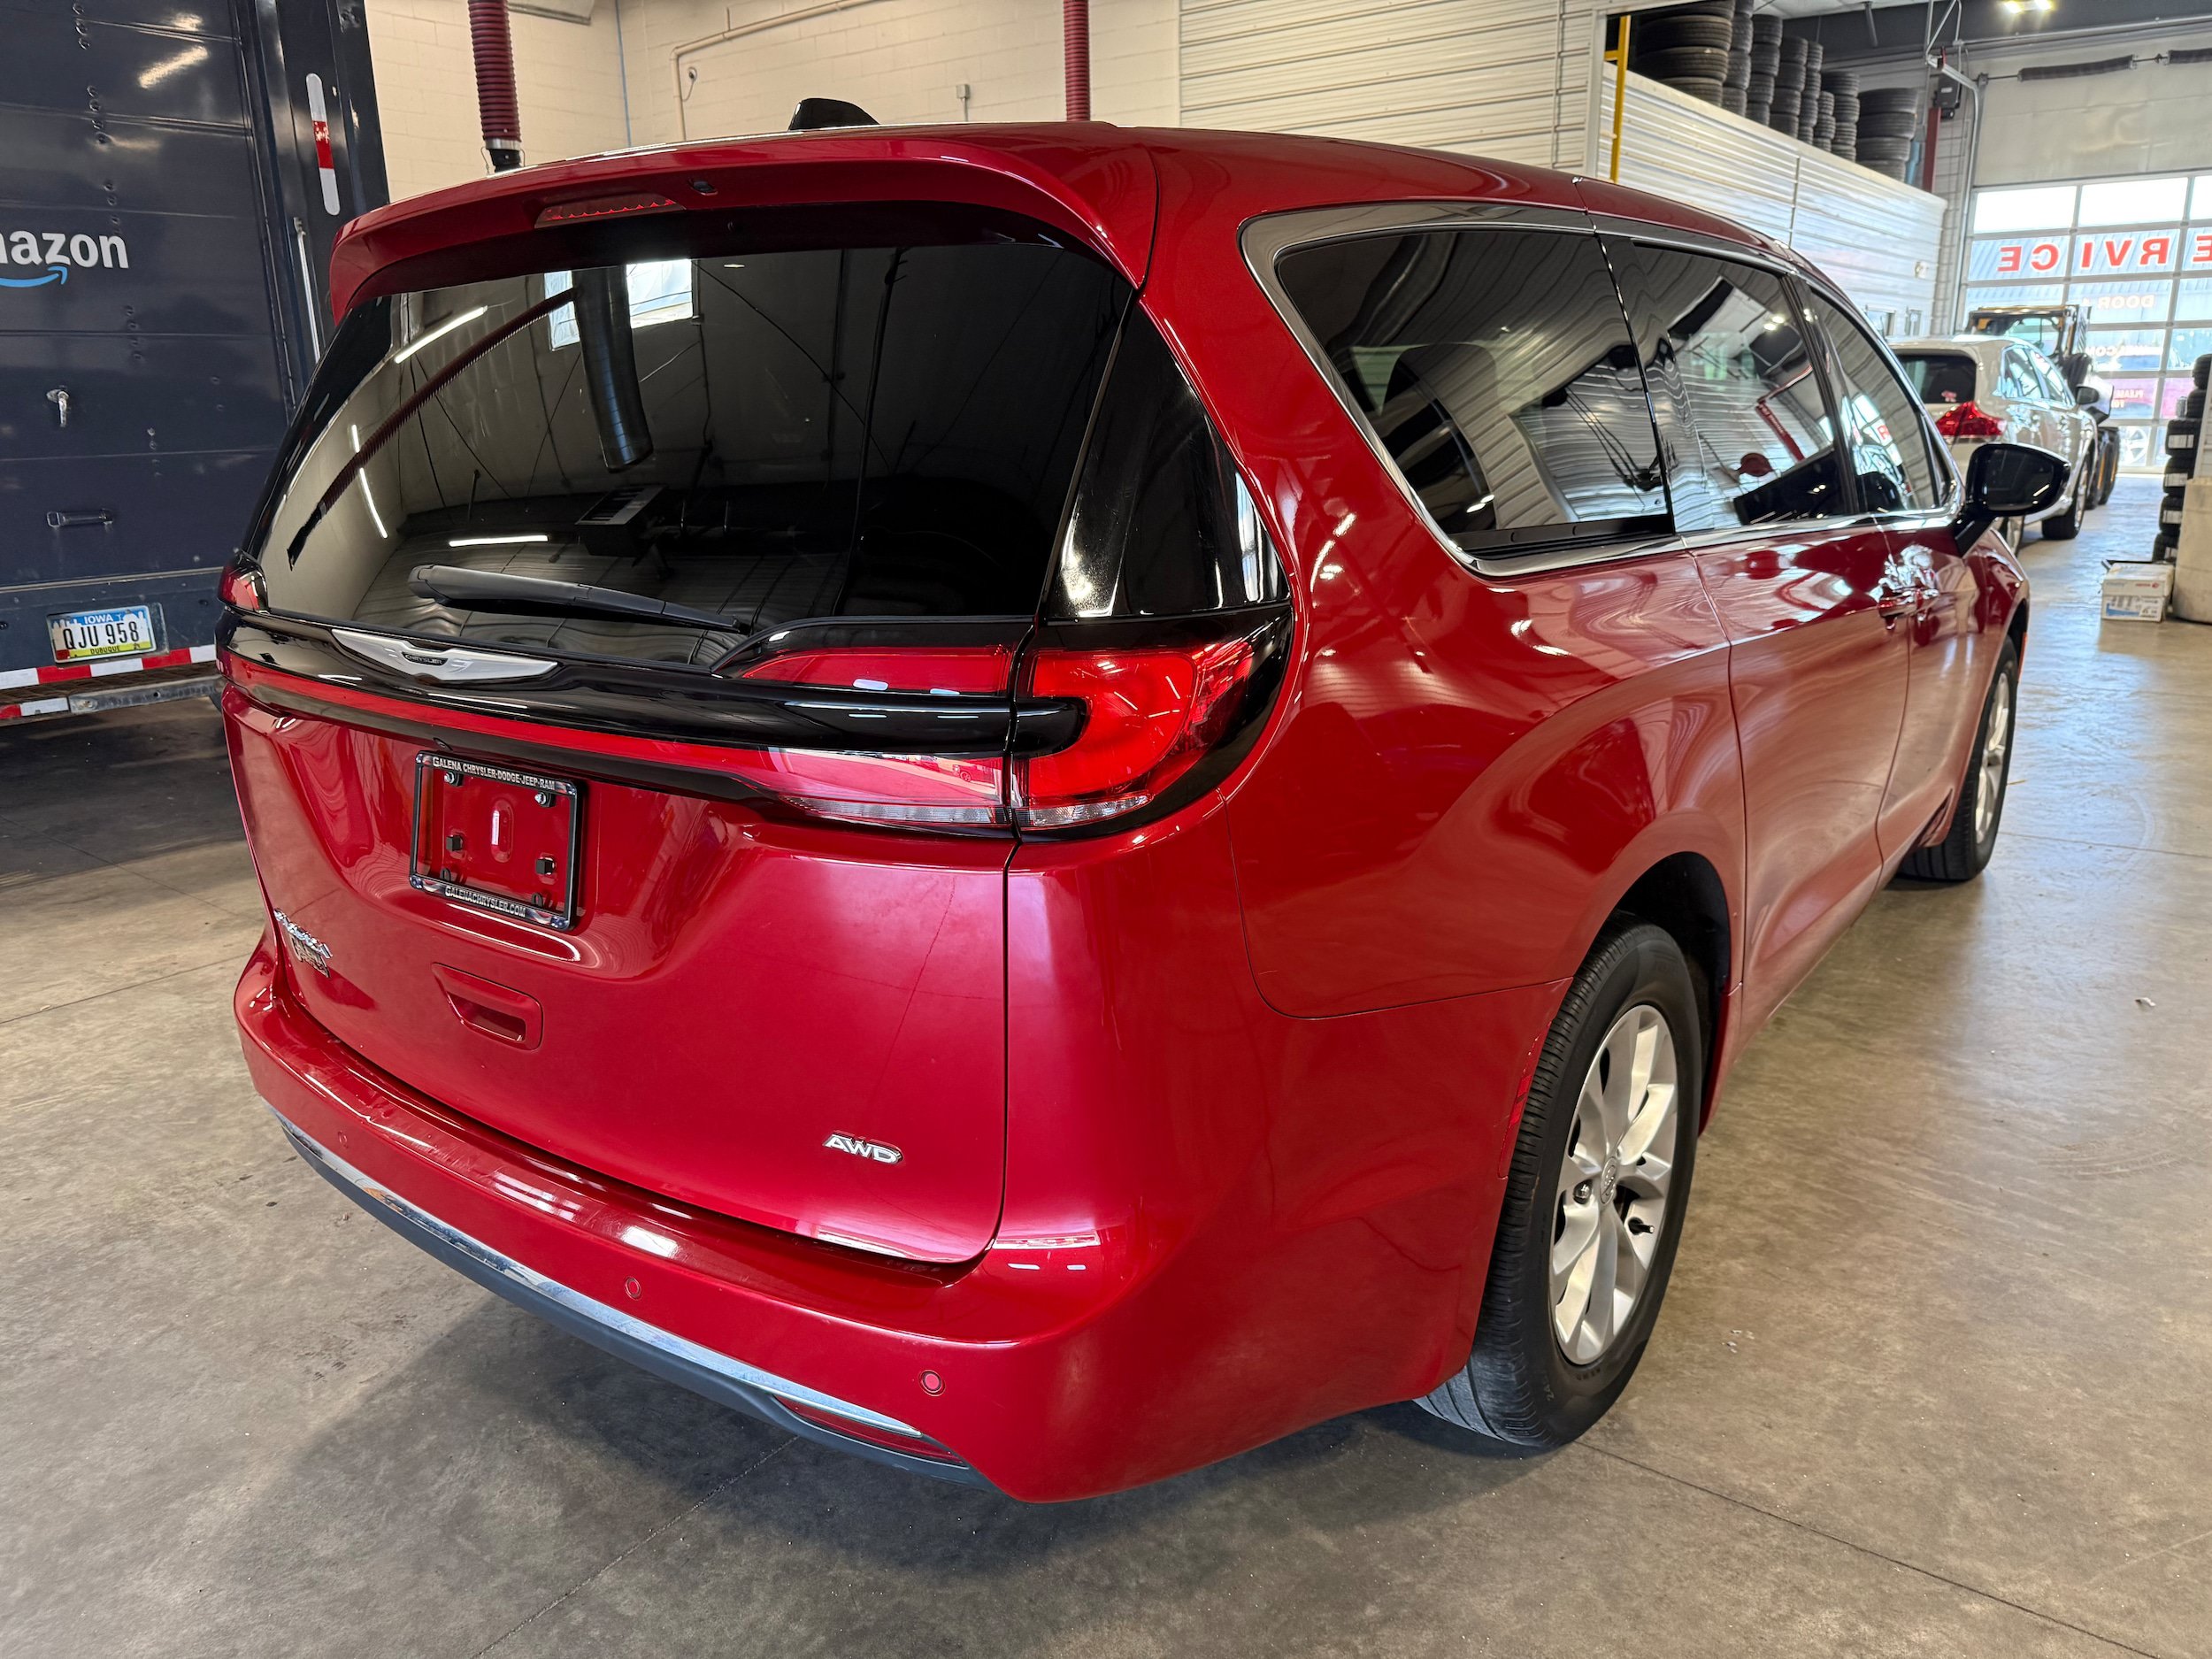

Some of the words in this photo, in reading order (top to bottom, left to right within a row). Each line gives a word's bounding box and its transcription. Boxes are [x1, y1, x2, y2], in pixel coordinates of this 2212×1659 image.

[0, 230, 129, 268] azon
[83, 613, 114, 624] IOWA
[63, 625, 99, 649] QJU
[105, 621, 140, 645] 958
[90, 645, 120, 655] DUBUQUE
[405, 654, 443, 664] CHRYSLER
[433, 757, 462, 772] GALENA
[445, 886, 526, 917] GALENACHRYSLER.COM
[823, 1133, 902, 1164] AWD
